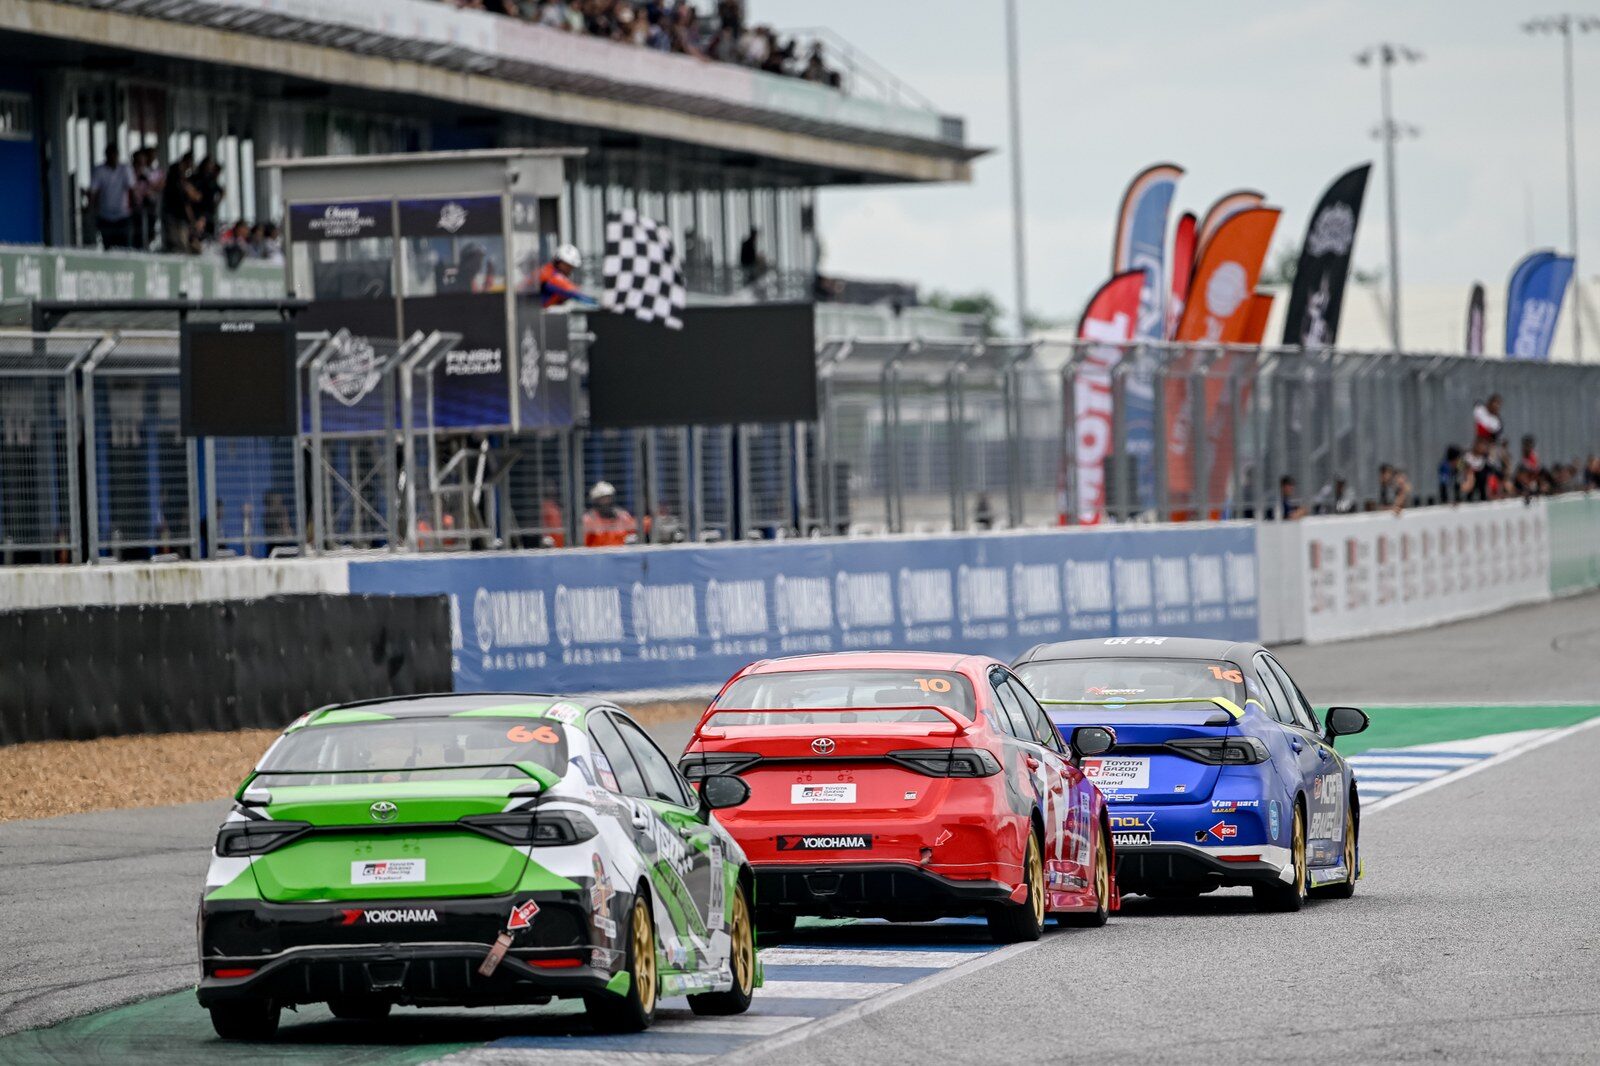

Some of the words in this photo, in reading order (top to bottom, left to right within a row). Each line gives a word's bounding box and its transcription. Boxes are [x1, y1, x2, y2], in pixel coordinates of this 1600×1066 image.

[1208, 666, 1243, 684] 16
[915, 677, 951, 693] 10
[507, 726, 560, 743] 66
[1211, 799, 1259, 808] Vanguard
[802, 836, 866, 848] YOKOHAMA
[1112, 833, 1149, 845] HAMA
[364, 908, 438, 923] YOKOHAMA
